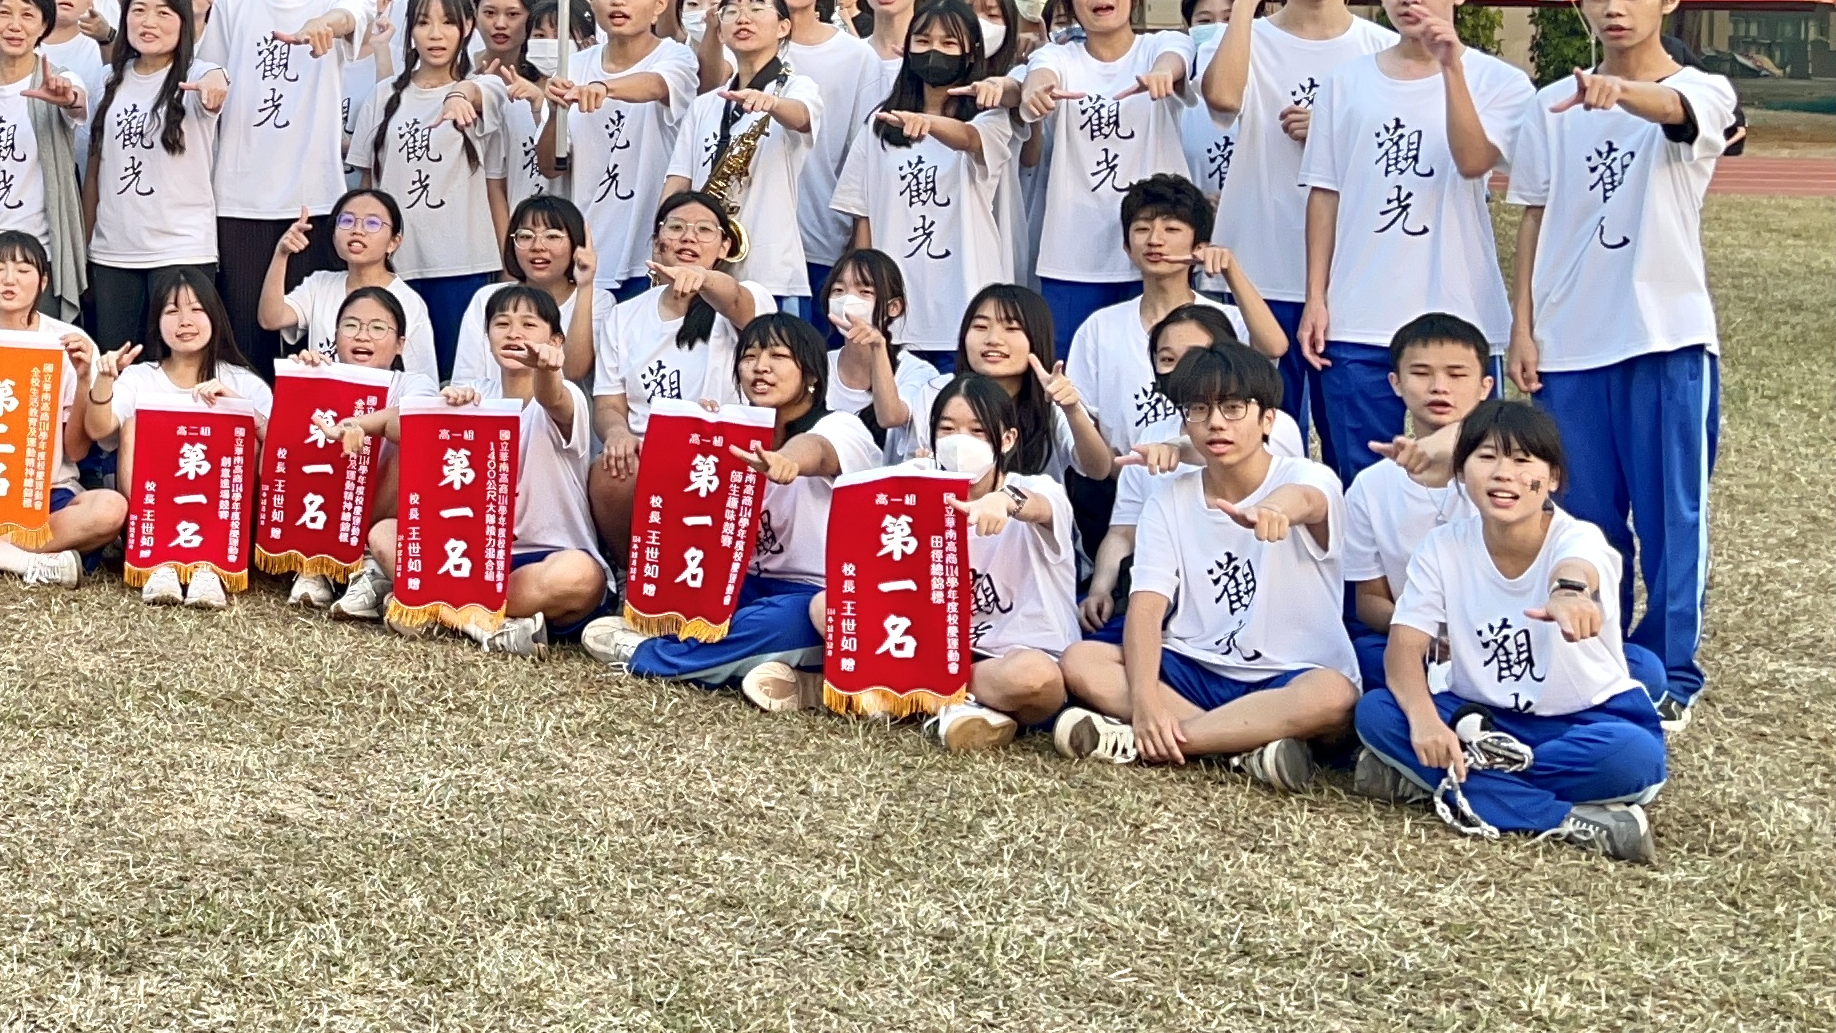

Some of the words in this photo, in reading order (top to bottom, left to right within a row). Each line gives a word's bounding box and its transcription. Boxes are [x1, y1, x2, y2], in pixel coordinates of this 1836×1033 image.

[253, 30, 298, 129] 觀光
[115, 102, 156, 197] 觀光
[398, 119, 445, 210] 觀光
[1078, 94, 1134, 192] 觀光
[1373, 117, 1433, 236] 觀光
[898, 154, 952, 260] 觀光
[176, 426, 211, 437] 高二組
[295, 408, 338, 530] 第一名
[438, 429, 474, 441] 高一組
[689, 433, 723, 447] 高一組
[168, 442, 211, 549] 第一名
[437, 448, 475, 578] 第一名
[674, 454, 719, 588] 第一名
[875, 493, 916, 506] 高一組
[875, 514, 918, 658] 第一名
